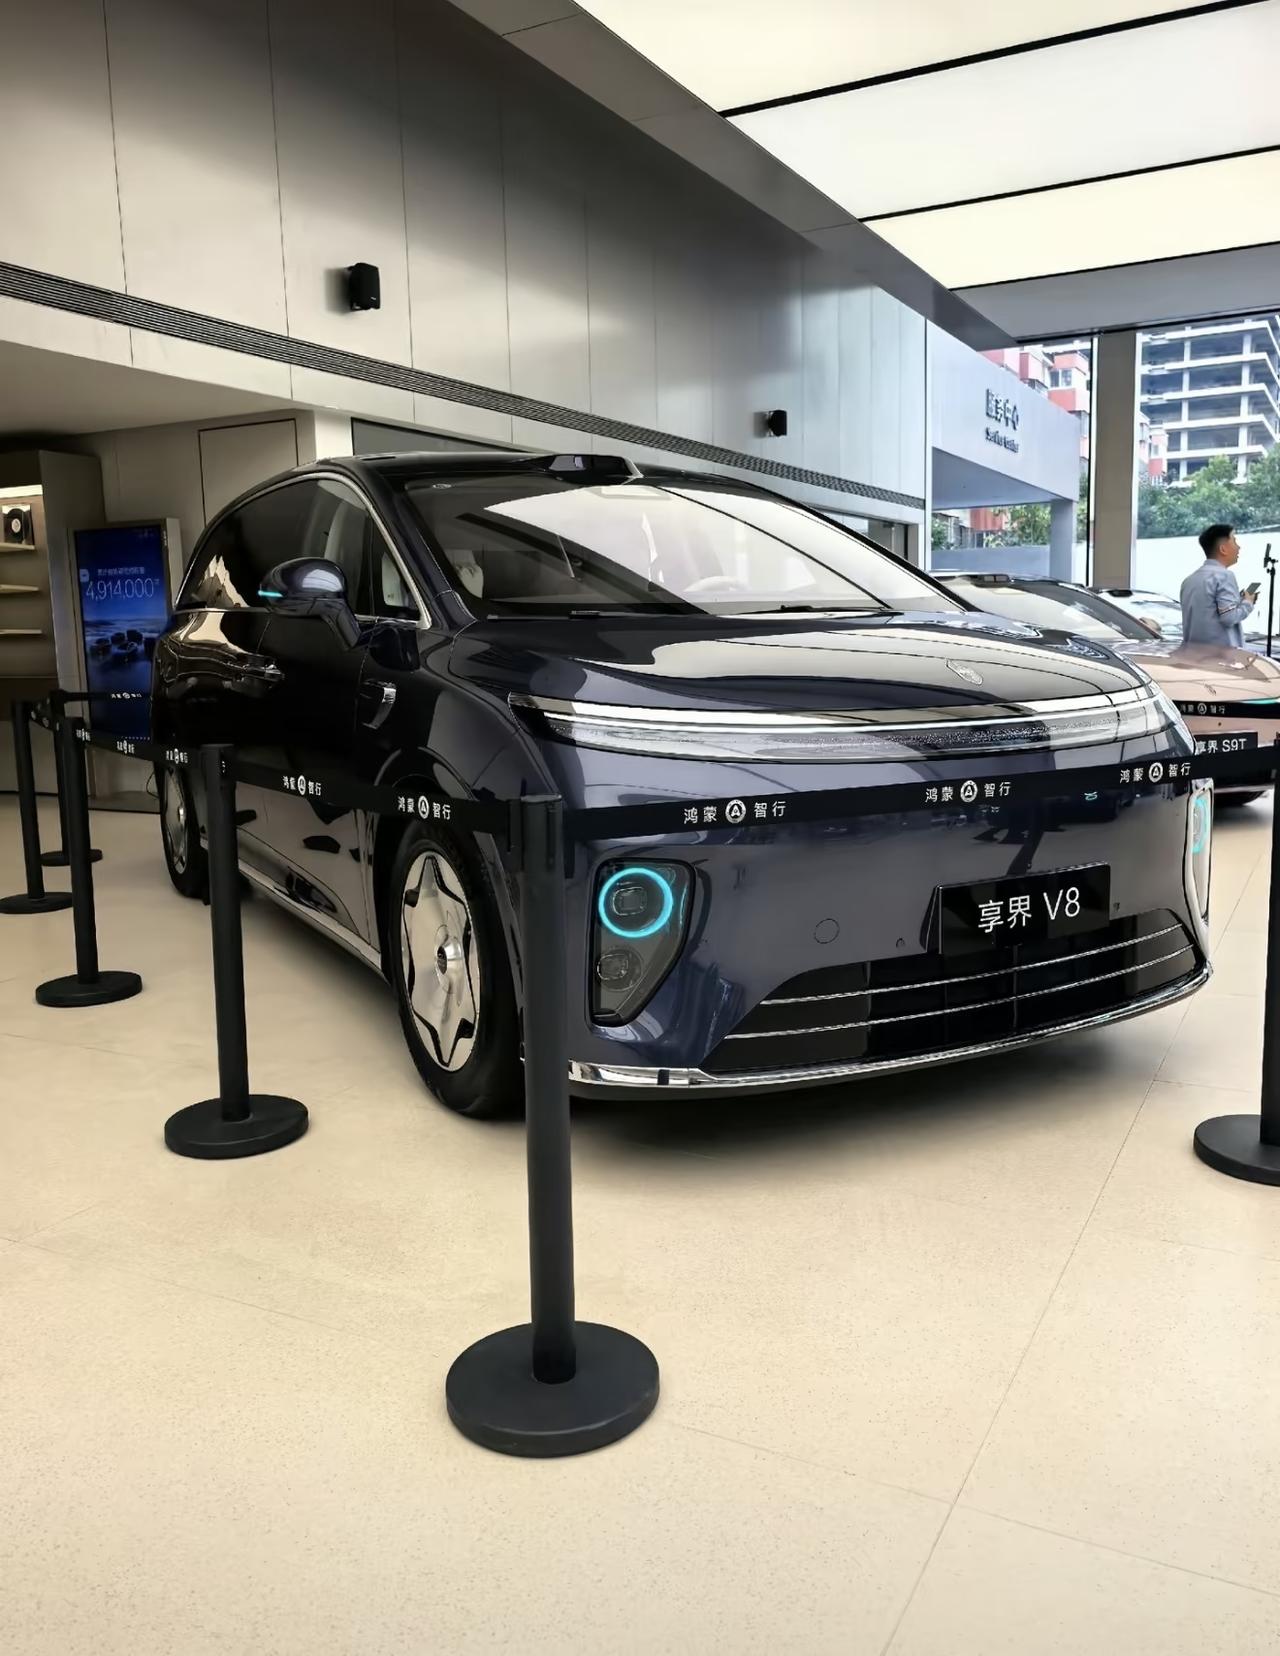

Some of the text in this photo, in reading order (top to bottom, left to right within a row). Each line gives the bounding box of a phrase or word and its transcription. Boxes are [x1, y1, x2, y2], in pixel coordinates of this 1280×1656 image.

[86, 578, 154, 601] 4,914,000
[1222, 738, 1247, 753] S9T
[978, 886, 1080, 933] 享界 V8
